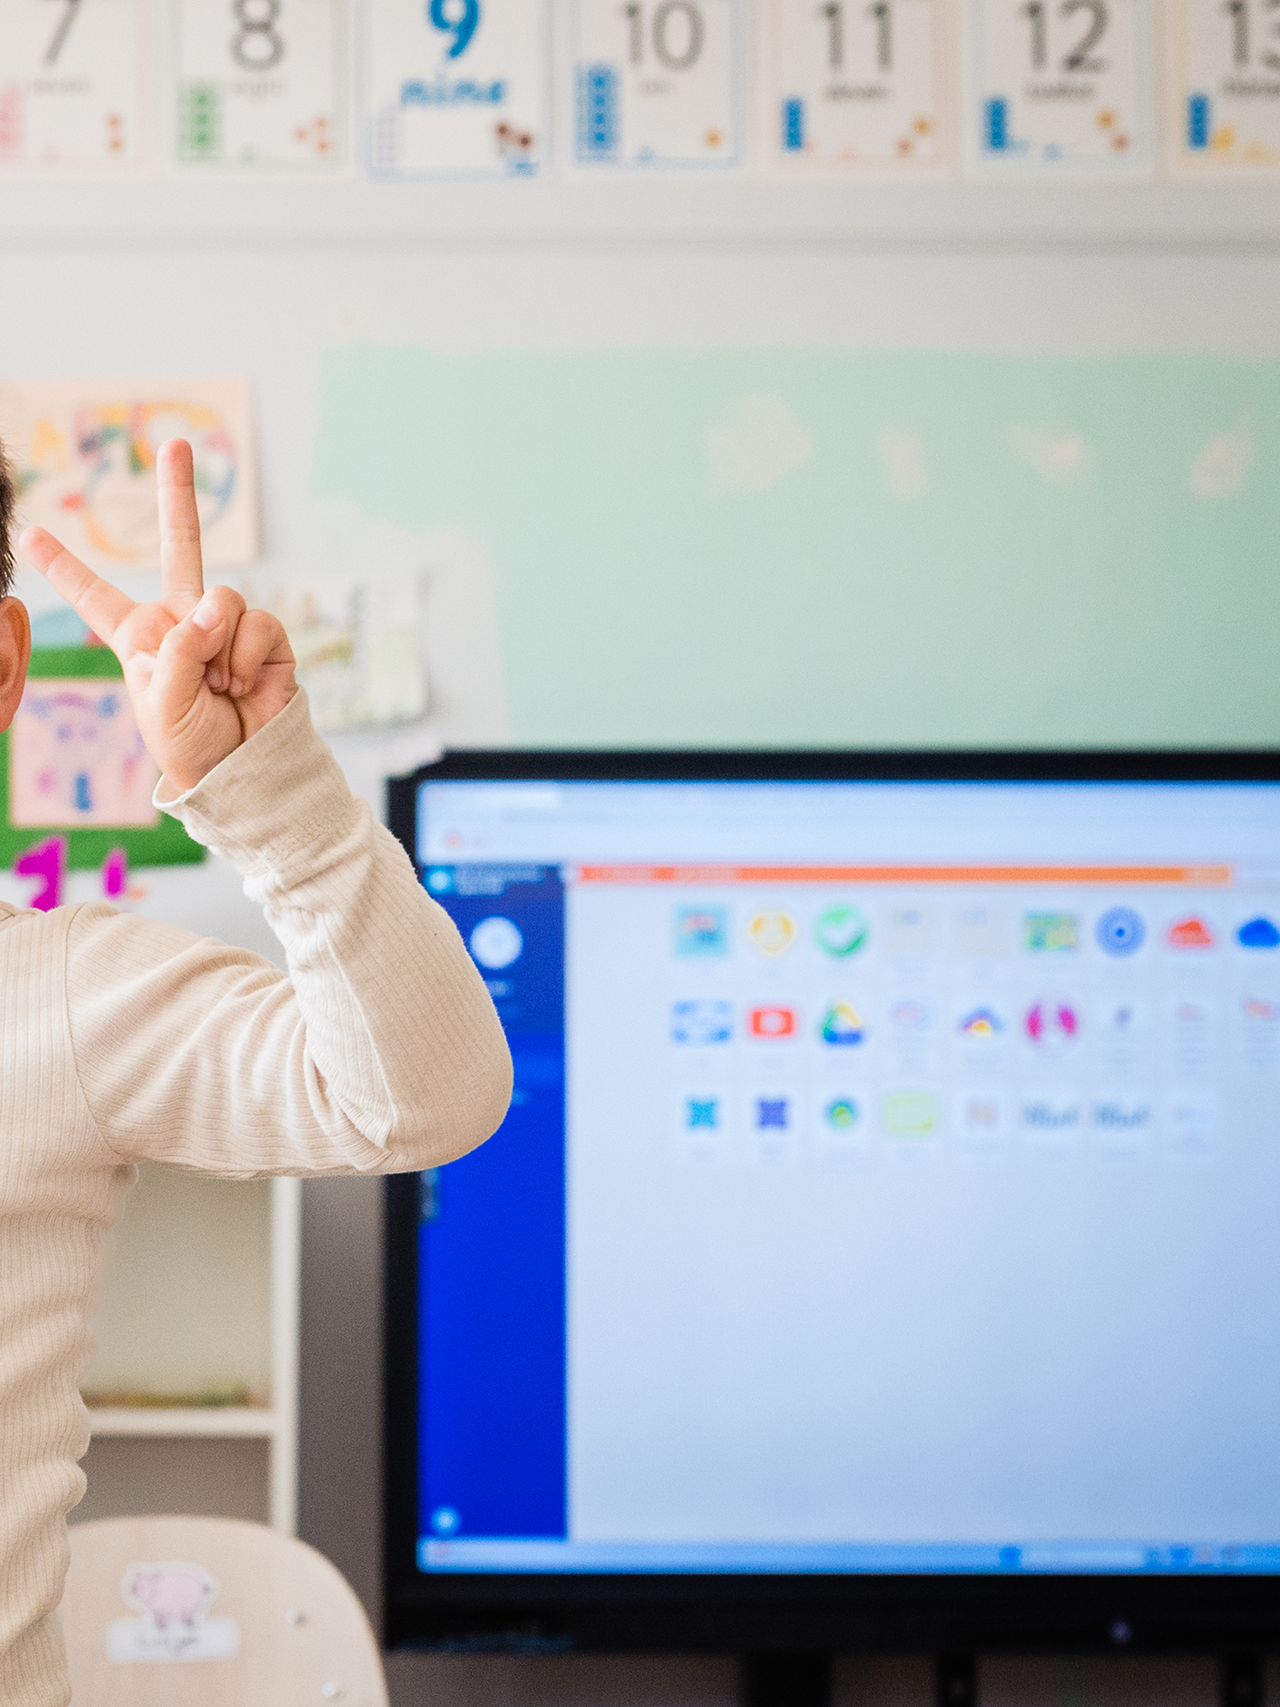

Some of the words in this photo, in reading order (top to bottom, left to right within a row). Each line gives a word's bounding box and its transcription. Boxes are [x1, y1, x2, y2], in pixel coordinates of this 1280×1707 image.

[41, 0, 86, 66] 7
[229, 0, 286, 71] 8
[428, 0, 481, 60] 9
[621, 0, 706, 71] 10
[822, 0, 894, 72] 11
[1025, 0, 1110, 72] 12
